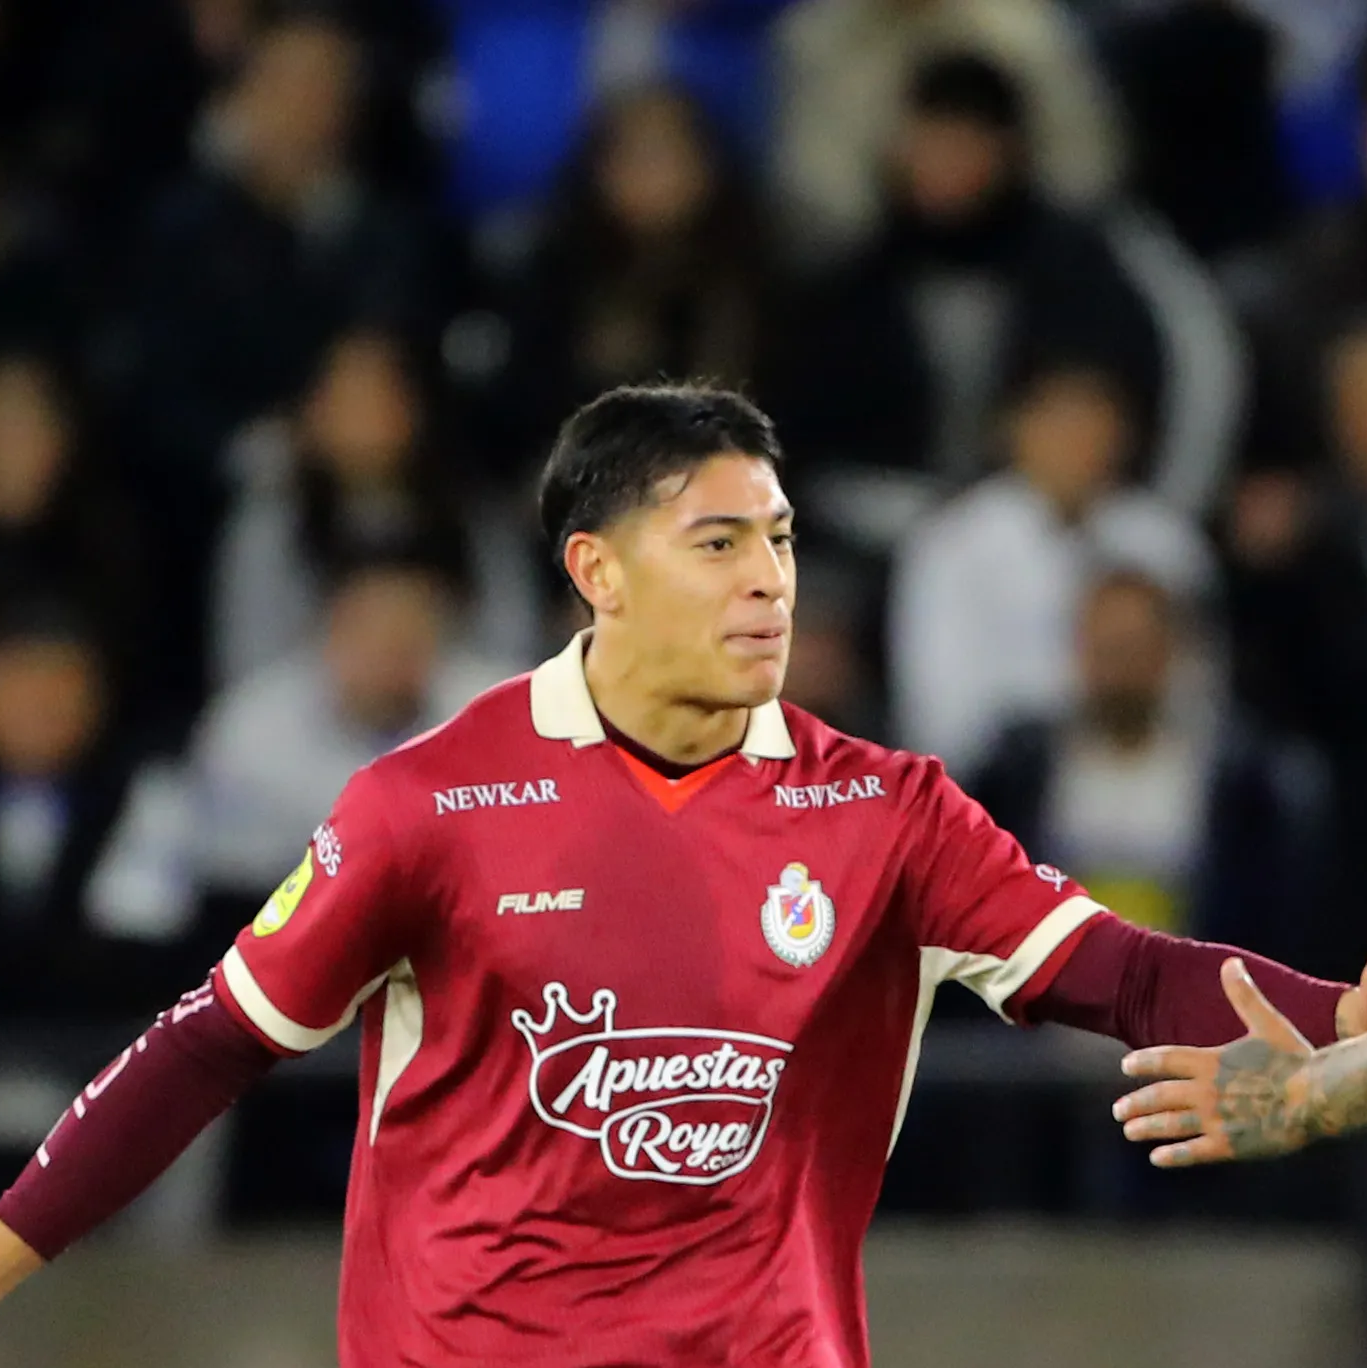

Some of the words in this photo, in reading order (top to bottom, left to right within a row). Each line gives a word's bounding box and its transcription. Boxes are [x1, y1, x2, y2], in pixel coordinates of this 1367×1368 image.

[433, 778, 561, 815] NEWKAR
[774, 774, 888, 809] NEWKAR
[496, 888, 585, 916] FIUME
[551, 1042, 785, 1114] Apuestas
